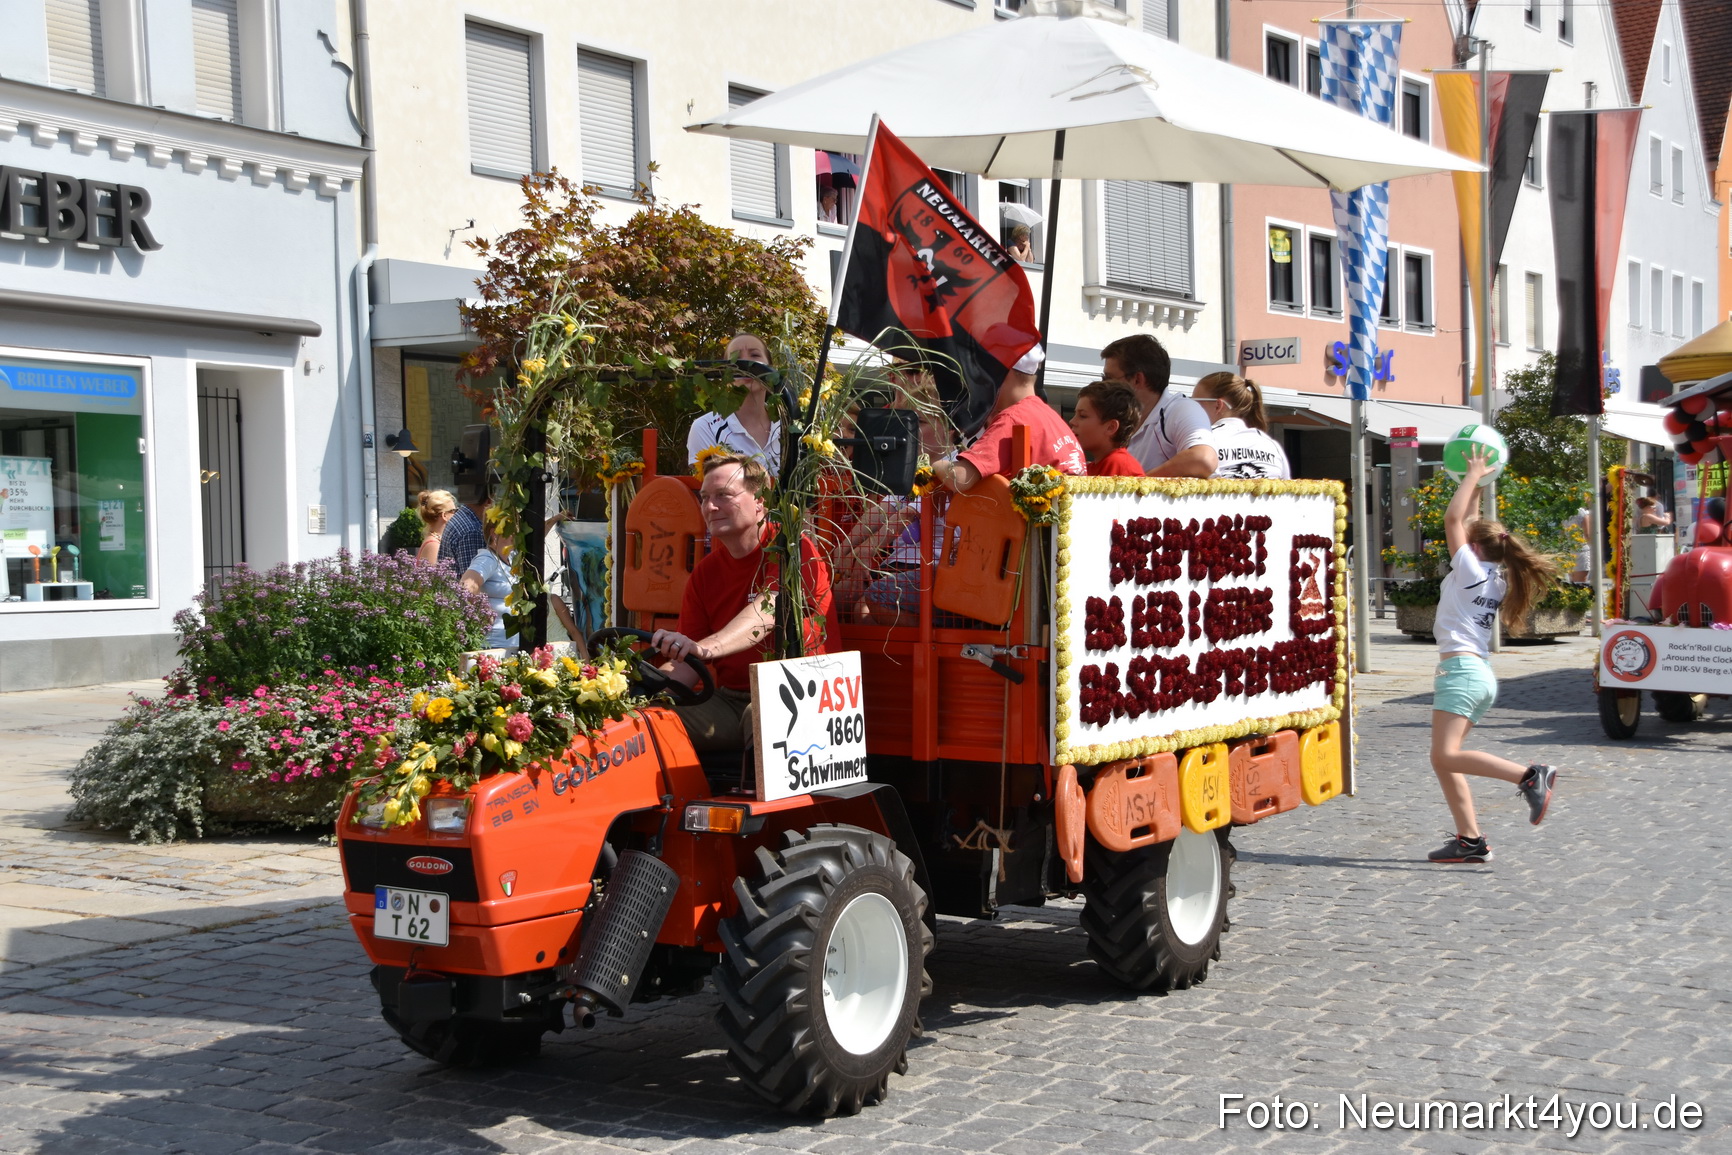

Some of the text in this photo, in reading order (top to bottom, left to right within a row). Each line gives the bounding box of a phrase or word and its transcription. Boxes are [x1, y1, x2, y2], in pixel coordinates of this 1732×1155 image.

[0, 165, 164, 251] EBER
[916, 183, 1008, 267] NEUMARKT
[17, 372, 129, 394] BRILLEN WEBER
[1231, 448, 1275, 464] NEUMARKT
[9, 488, 28, 497] 35%
[649, 521, 676, 580] ASV
[1674, 665, 1701, 673] DJK-SV
[1703, 667, 1721, 675] Berg
[818, 675, 861, 713] ASV
[826, 713, 863, 746] 1860
[553, 732, 646, 796] GOLDONI
[1246, 760, 1262, 796] ASV
[1203, 773, 1219, 803] ASV
[492, 797, 540, 828] 28 SN
[1125, 791, 1156, 826] ASV
[409, 861, 449, 871] GOLDONI
[379, 900, 384, 908] D
[408, 893, 420, 916] N
[392, 914, 430, 940] T 62
